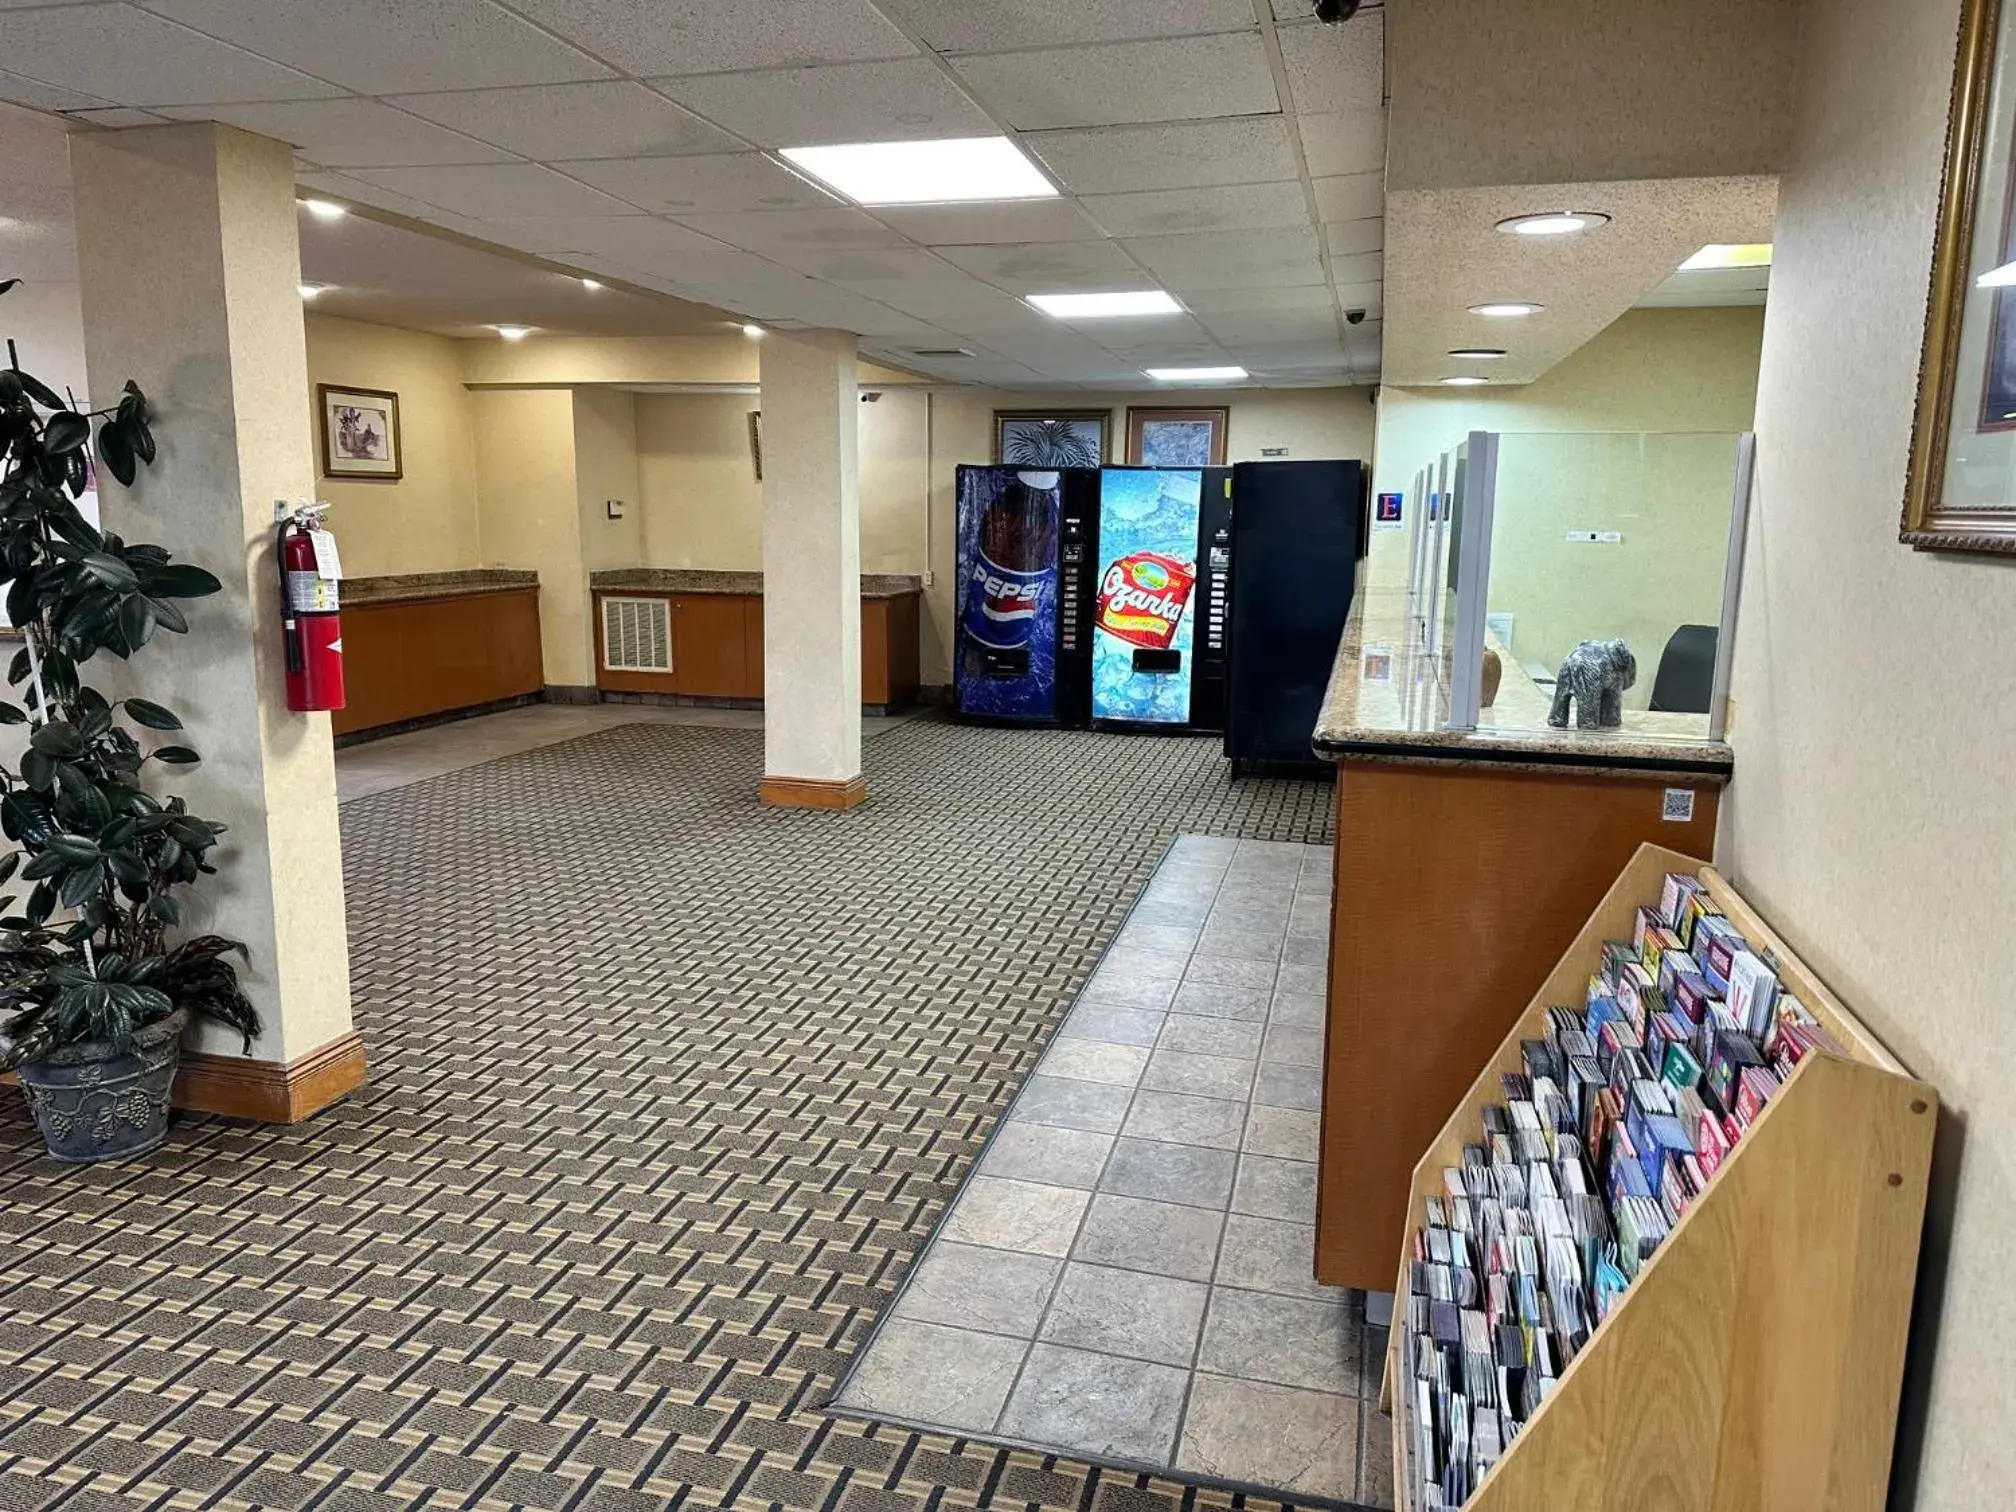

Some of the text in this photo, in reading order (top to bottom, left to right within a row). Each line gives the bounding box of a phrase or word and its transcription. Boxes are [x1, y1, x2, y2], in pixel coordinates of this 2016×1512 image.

[1382, 495, 1397, 518] E
[972, 563, 1045, 602] PEPSI
[1103, 566, 1184, 622] Ozarka
